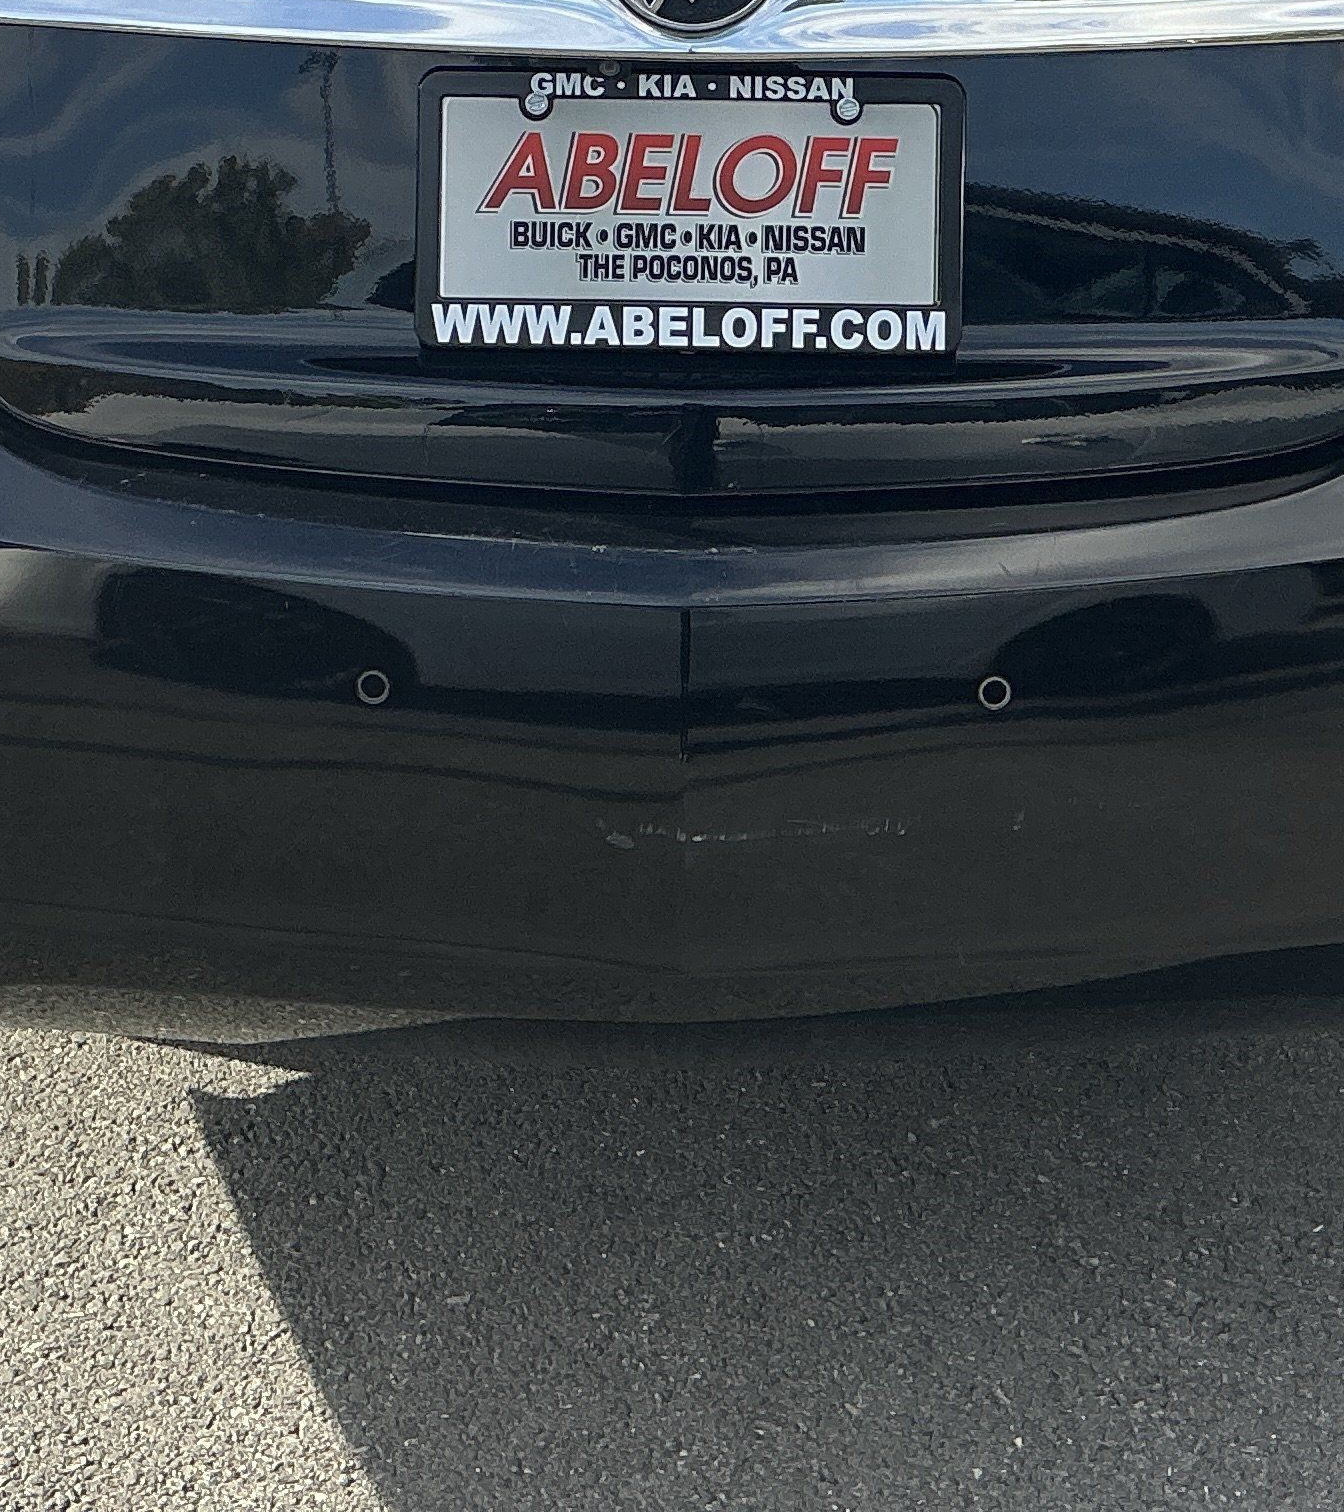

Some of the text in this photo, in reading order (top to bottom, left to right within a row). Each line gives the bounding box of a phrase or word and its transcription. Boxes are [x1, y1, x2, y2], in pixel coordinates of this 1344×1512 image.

[529, 71, 854, 101] GMC KIA NISSAN
[476, 130, 899, 219] ABELOFF
[510, 220, 866, 254] BUICK GMC KIA NISSAN
[576, 253, 799, 287] THE POCONOS, PA
[430, 302, 947, 351] WWW.ABELOFF.COM
